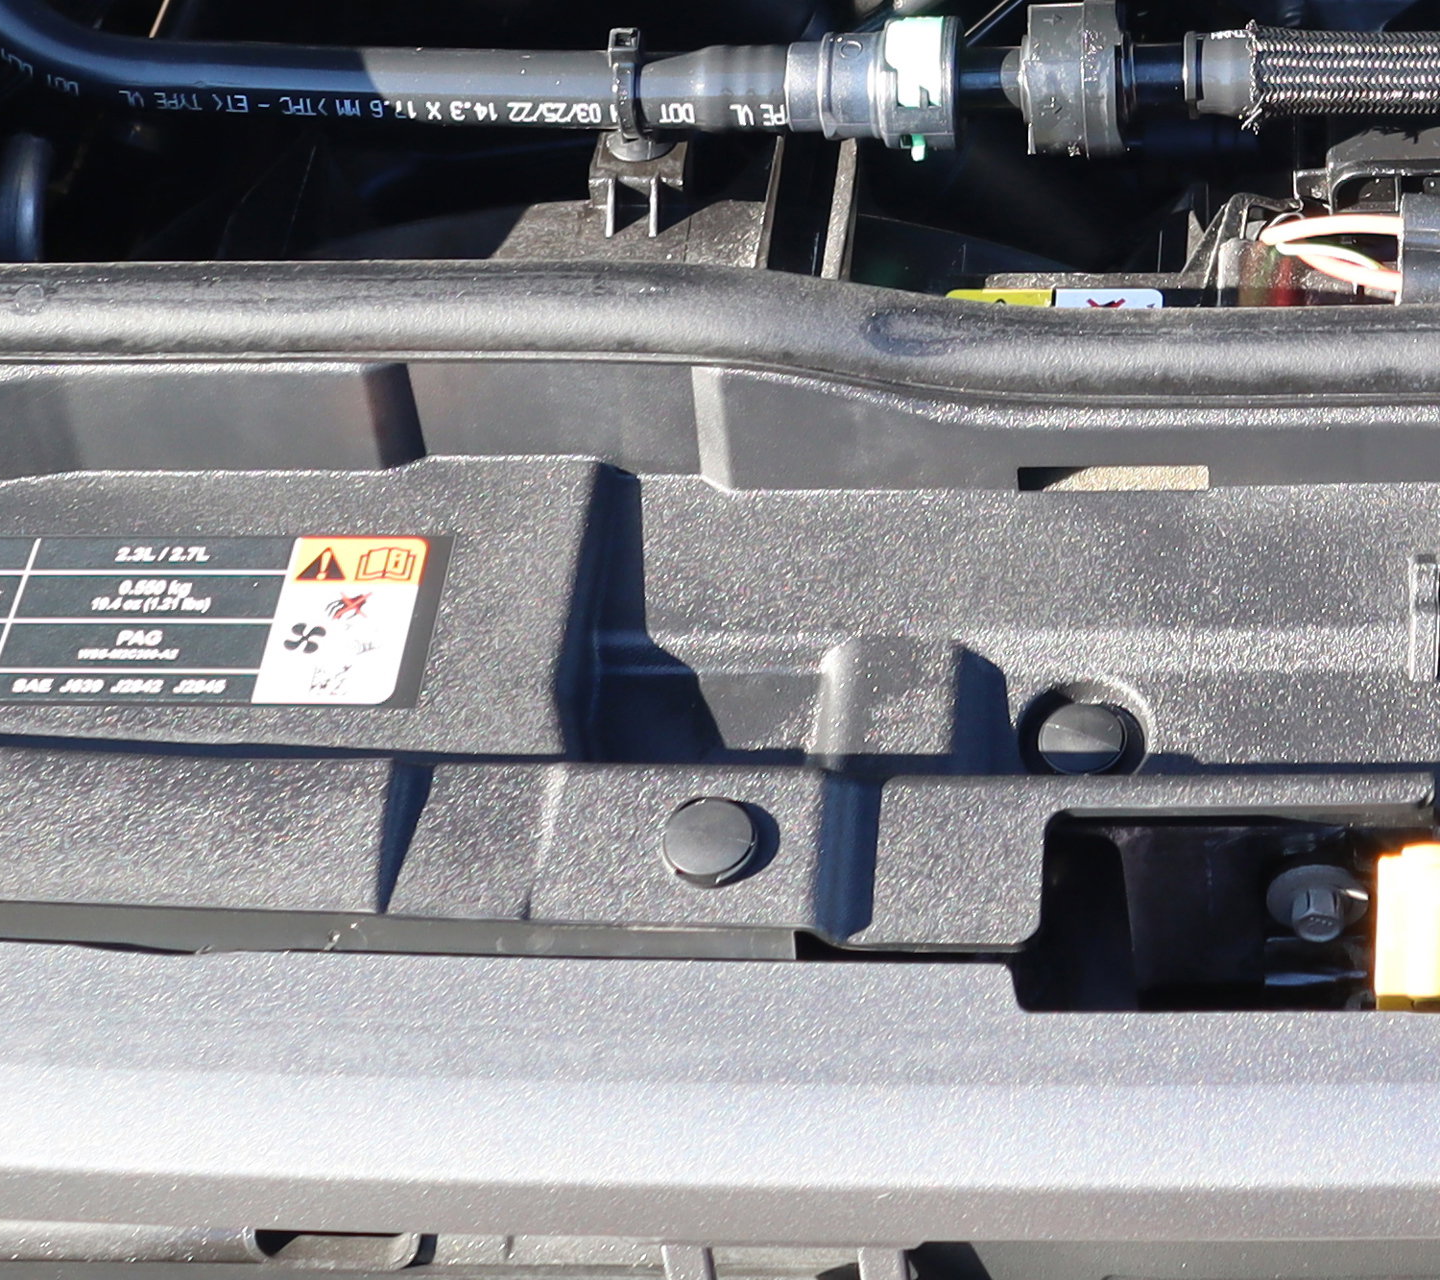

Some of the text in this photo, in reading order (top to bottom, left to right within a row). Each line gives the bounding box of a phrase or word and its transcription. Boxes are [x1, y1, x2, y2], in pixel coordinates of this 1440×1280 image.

[156, 90, 203, 112] TYPE
[369, 98, 417, 119] 17.6
[426, 100, 442, 120] X
[450, 100, 498, 121] 14.3
[509, 100, 602, 123] 03/25/22
[658, 103, 696, 124] DOT
[114, 546, 156, 562] 2.3L
[168, 546, 211, 562] 2.7L
[168, 580, 193, 599] kg
[122, 598, 142, 611] oz
[143, 596, 179, 614] (1.21
[181, 596, 212, 614] lbs)
[116, 630, 163, 646] PAG
[11, 678, 55, 693] SAE
